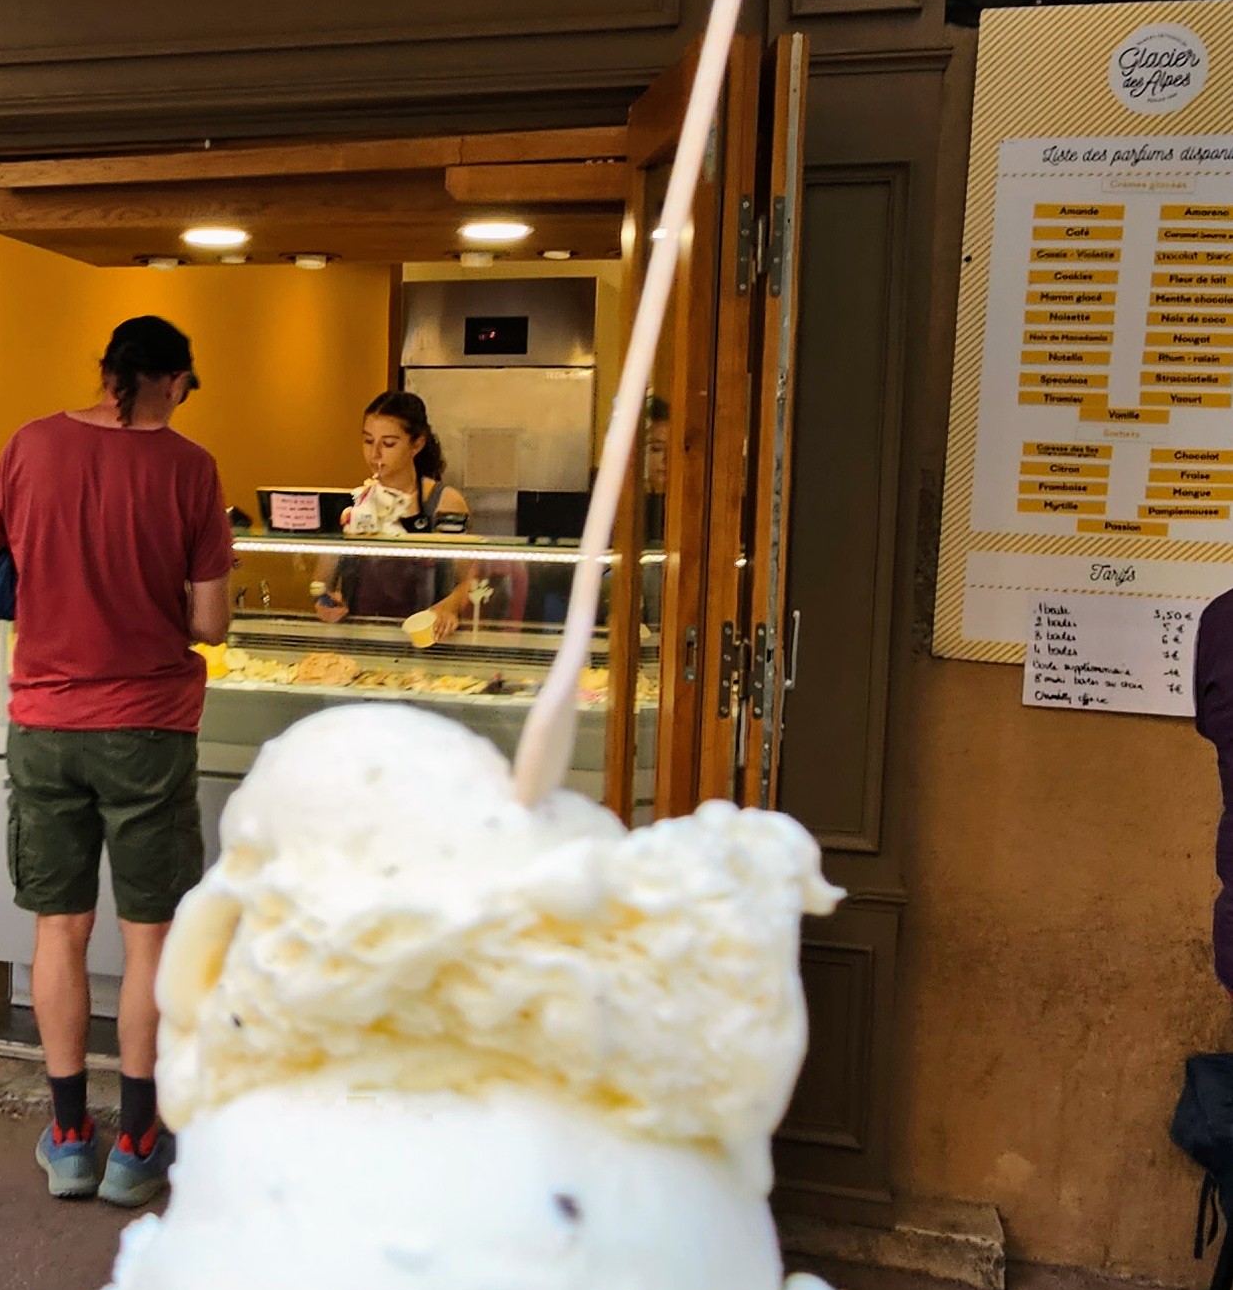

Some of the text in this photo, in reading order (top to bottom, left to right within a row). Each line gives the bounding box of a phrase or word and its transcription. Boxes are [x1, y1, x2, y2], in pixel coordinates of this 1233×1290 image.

[1119, 47, 1200, 76] Glacier
[1123, 70, 1191, 97] des Alpes
[1042, 145, 1078, 166] Liste
[1082, 147, 1107, 162] des
[1110, 144, 1174, 167] parfums
[1059, 206, 1099, 216] Amande
[1066, 228, 1090, 237] Café
[1054, 271, 1093, 281] Cookies
[1169, 275, 1227, 284] Fleur de lait
[1040, 292, 1102, 303] Marron glacé
[1156, 293, 1191, 303] Menthe
[1049, 312, 1090, 321] Noisette
[1161, 314, 1226, 324] Noix de coco
[1173, 335, 1210, 345] Nougat
[1048, 352, 1083, 361] Nutella
[1158, 353, 1220, 363] Rhum raisin
[1040, 375, 1088, 386] Speculoos
[1155, 373, 1219, 384] Stracciatella
[1044, 394, 1083, 403] Tiramisu
[1170, 394, 1202, 404] Yaourt
[1108, 410, 1140, 421] Vanille
[1174, 451, 1219, 461] Chocolat
[1049, 464, 1080, 474] Citron
[1180, 471, 1210, 480] Fraise
[1038, 482, 1087, 492] Framboise
[1172, 488, 1211, 499] Mangue
[1044, 501, 1078, 511] Myrtille
[1148, 506, 1219, 517] Pamplemousse
[1104, 521, 1141, 531] Passion
[1090, 563, 1136, 586] Tarifs
